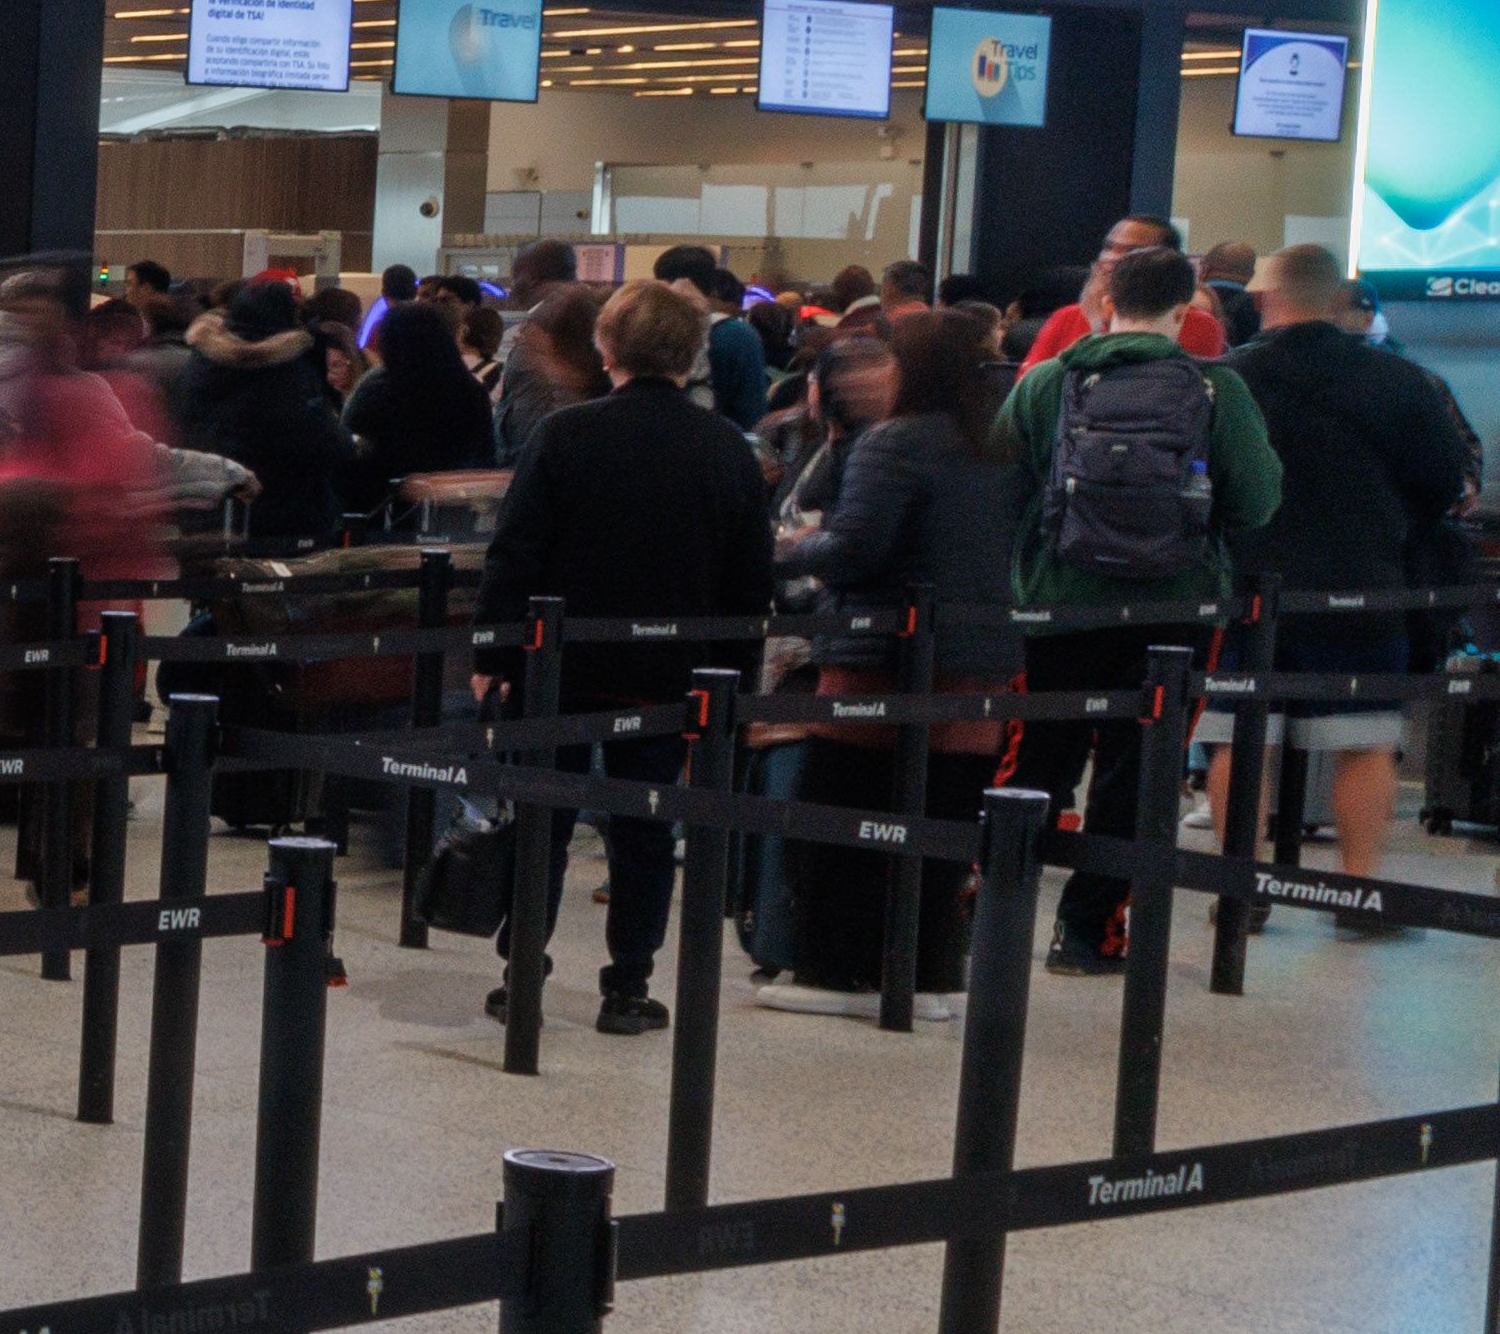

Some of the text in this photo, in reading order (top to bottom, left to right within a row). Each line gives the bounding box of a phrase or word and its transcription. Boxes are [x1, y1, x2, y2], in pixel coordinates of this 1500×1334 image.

[477, 6, 538, 31] Travel
[990, 38, 1038, 61] Travel
[382, 757, 467, 784] Terminal A
[859, 821, 906, 843] EWR
[1255, 872, 1382, 911] Terminal A
[158, 908, 200, 930] EWR
[1088, 1162, 1204, 1206] Terminal A
